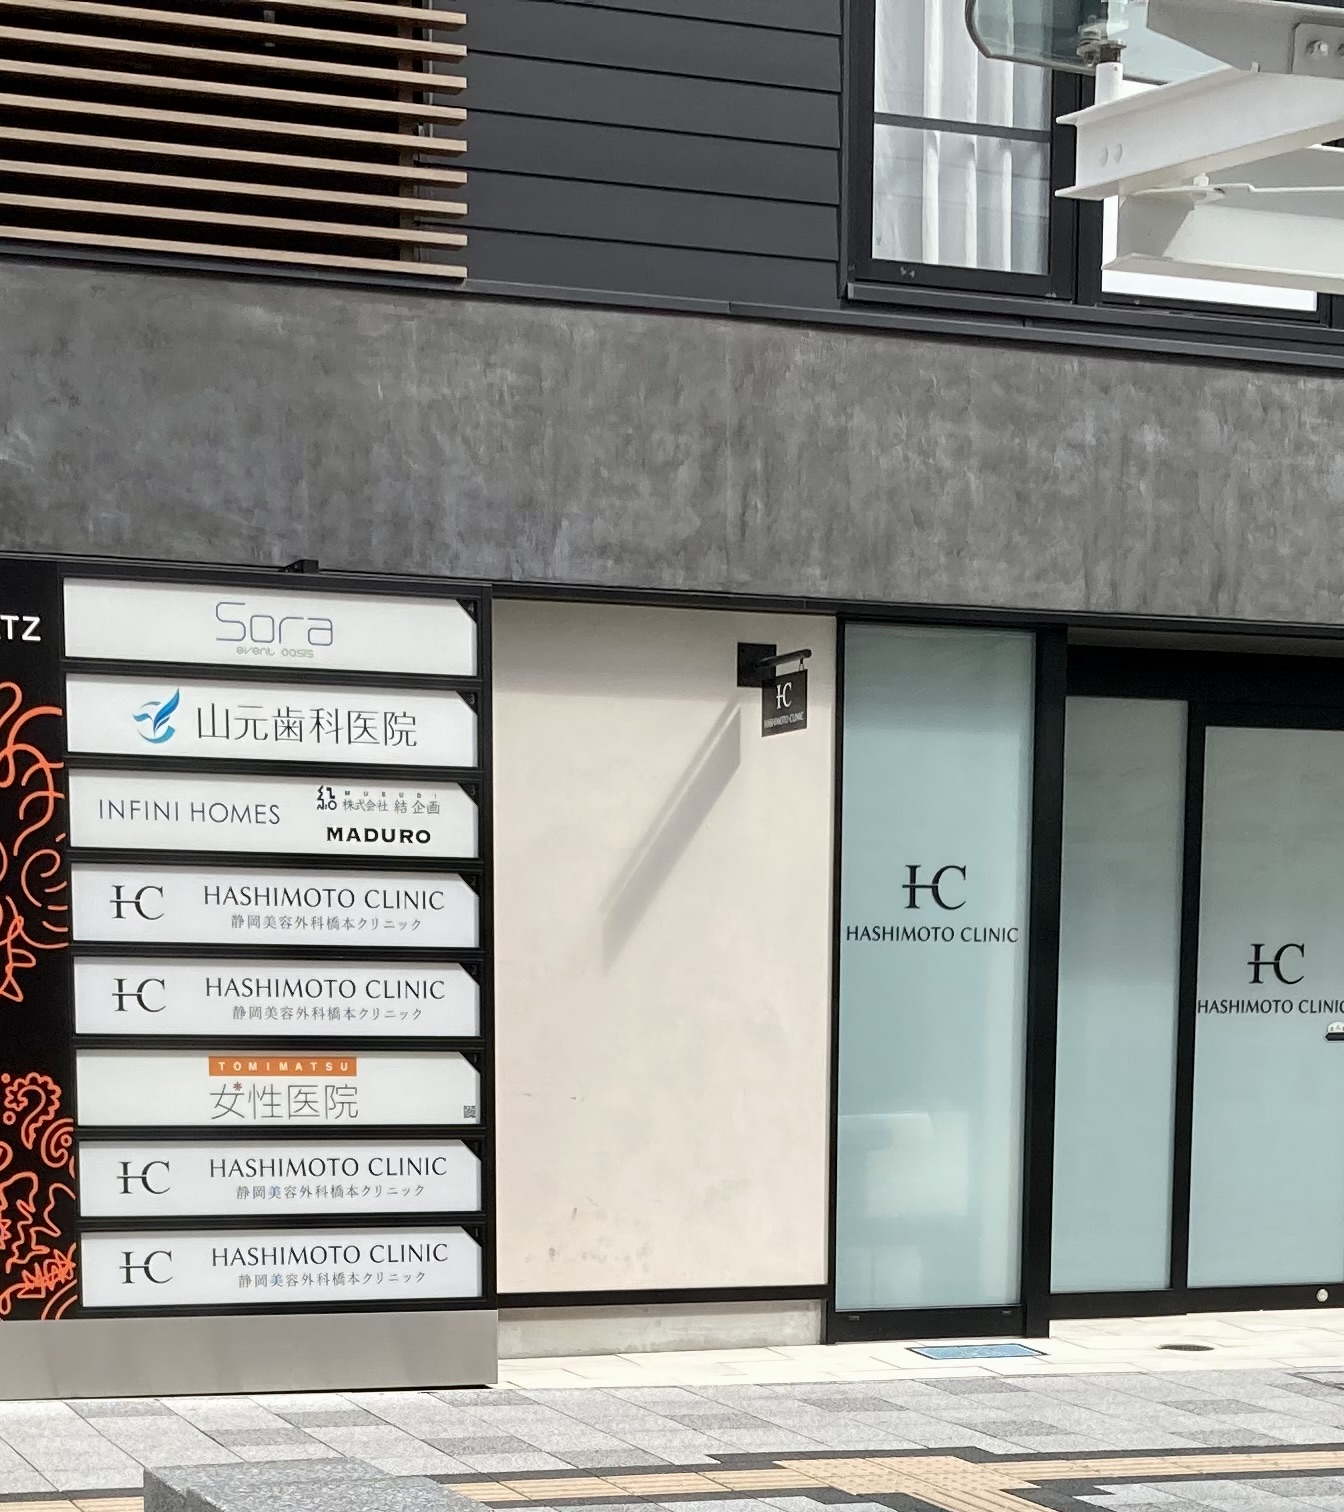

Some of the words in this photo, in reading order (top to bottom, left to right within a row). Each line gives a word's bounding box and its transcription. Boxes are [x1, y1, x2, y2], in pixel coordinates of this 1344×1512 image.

[215, 601, 334, 647] Sora
[236, 645, 275, 657] event
[281, 647, 314, 658] oasis
[197, 702, 417, 747] 山元歯科医院
[99, 798, 179, 823] INFINI
[190, 802, 281, 826] HOMES
[326, 826, 431, 844] MADURO
[203, 885, 356, 909] HASHIMOTO
[364, 889, 445, 911] CLINIC
[230, 914, 422, 932] 静岡美容外科橋本クリニック
[846, 925, 954, 942] HASHIMOTO
[960, 926, 1019, 943] CLINIC
[205, 977, 357, 999] HASHIMOTO
[365, 979, 446, 1000] CLINIC
[232, 1005, 423, 1021] 静岡美容外科橋本クリニック
[1197, 999, 1294, 1014] HASHIMOTO
[218, 1061, 349, 1072] TOMIMATSU
[209, 1082, 359, 1120] 女性医院
[209, 1156, 360, 1178] HASHIMOTO
[367, 1156, 448, 1177] CLINIC
[235, 1183, 425, 1200] 静岡美容外科橋本クリニック
[211, 1244, 362, 1267] HASHIMOTO
[369, 1243, 449, 1264] CLINIC
[237, 1271, 426, 1288] 静岡美容外科橋本クリニック
